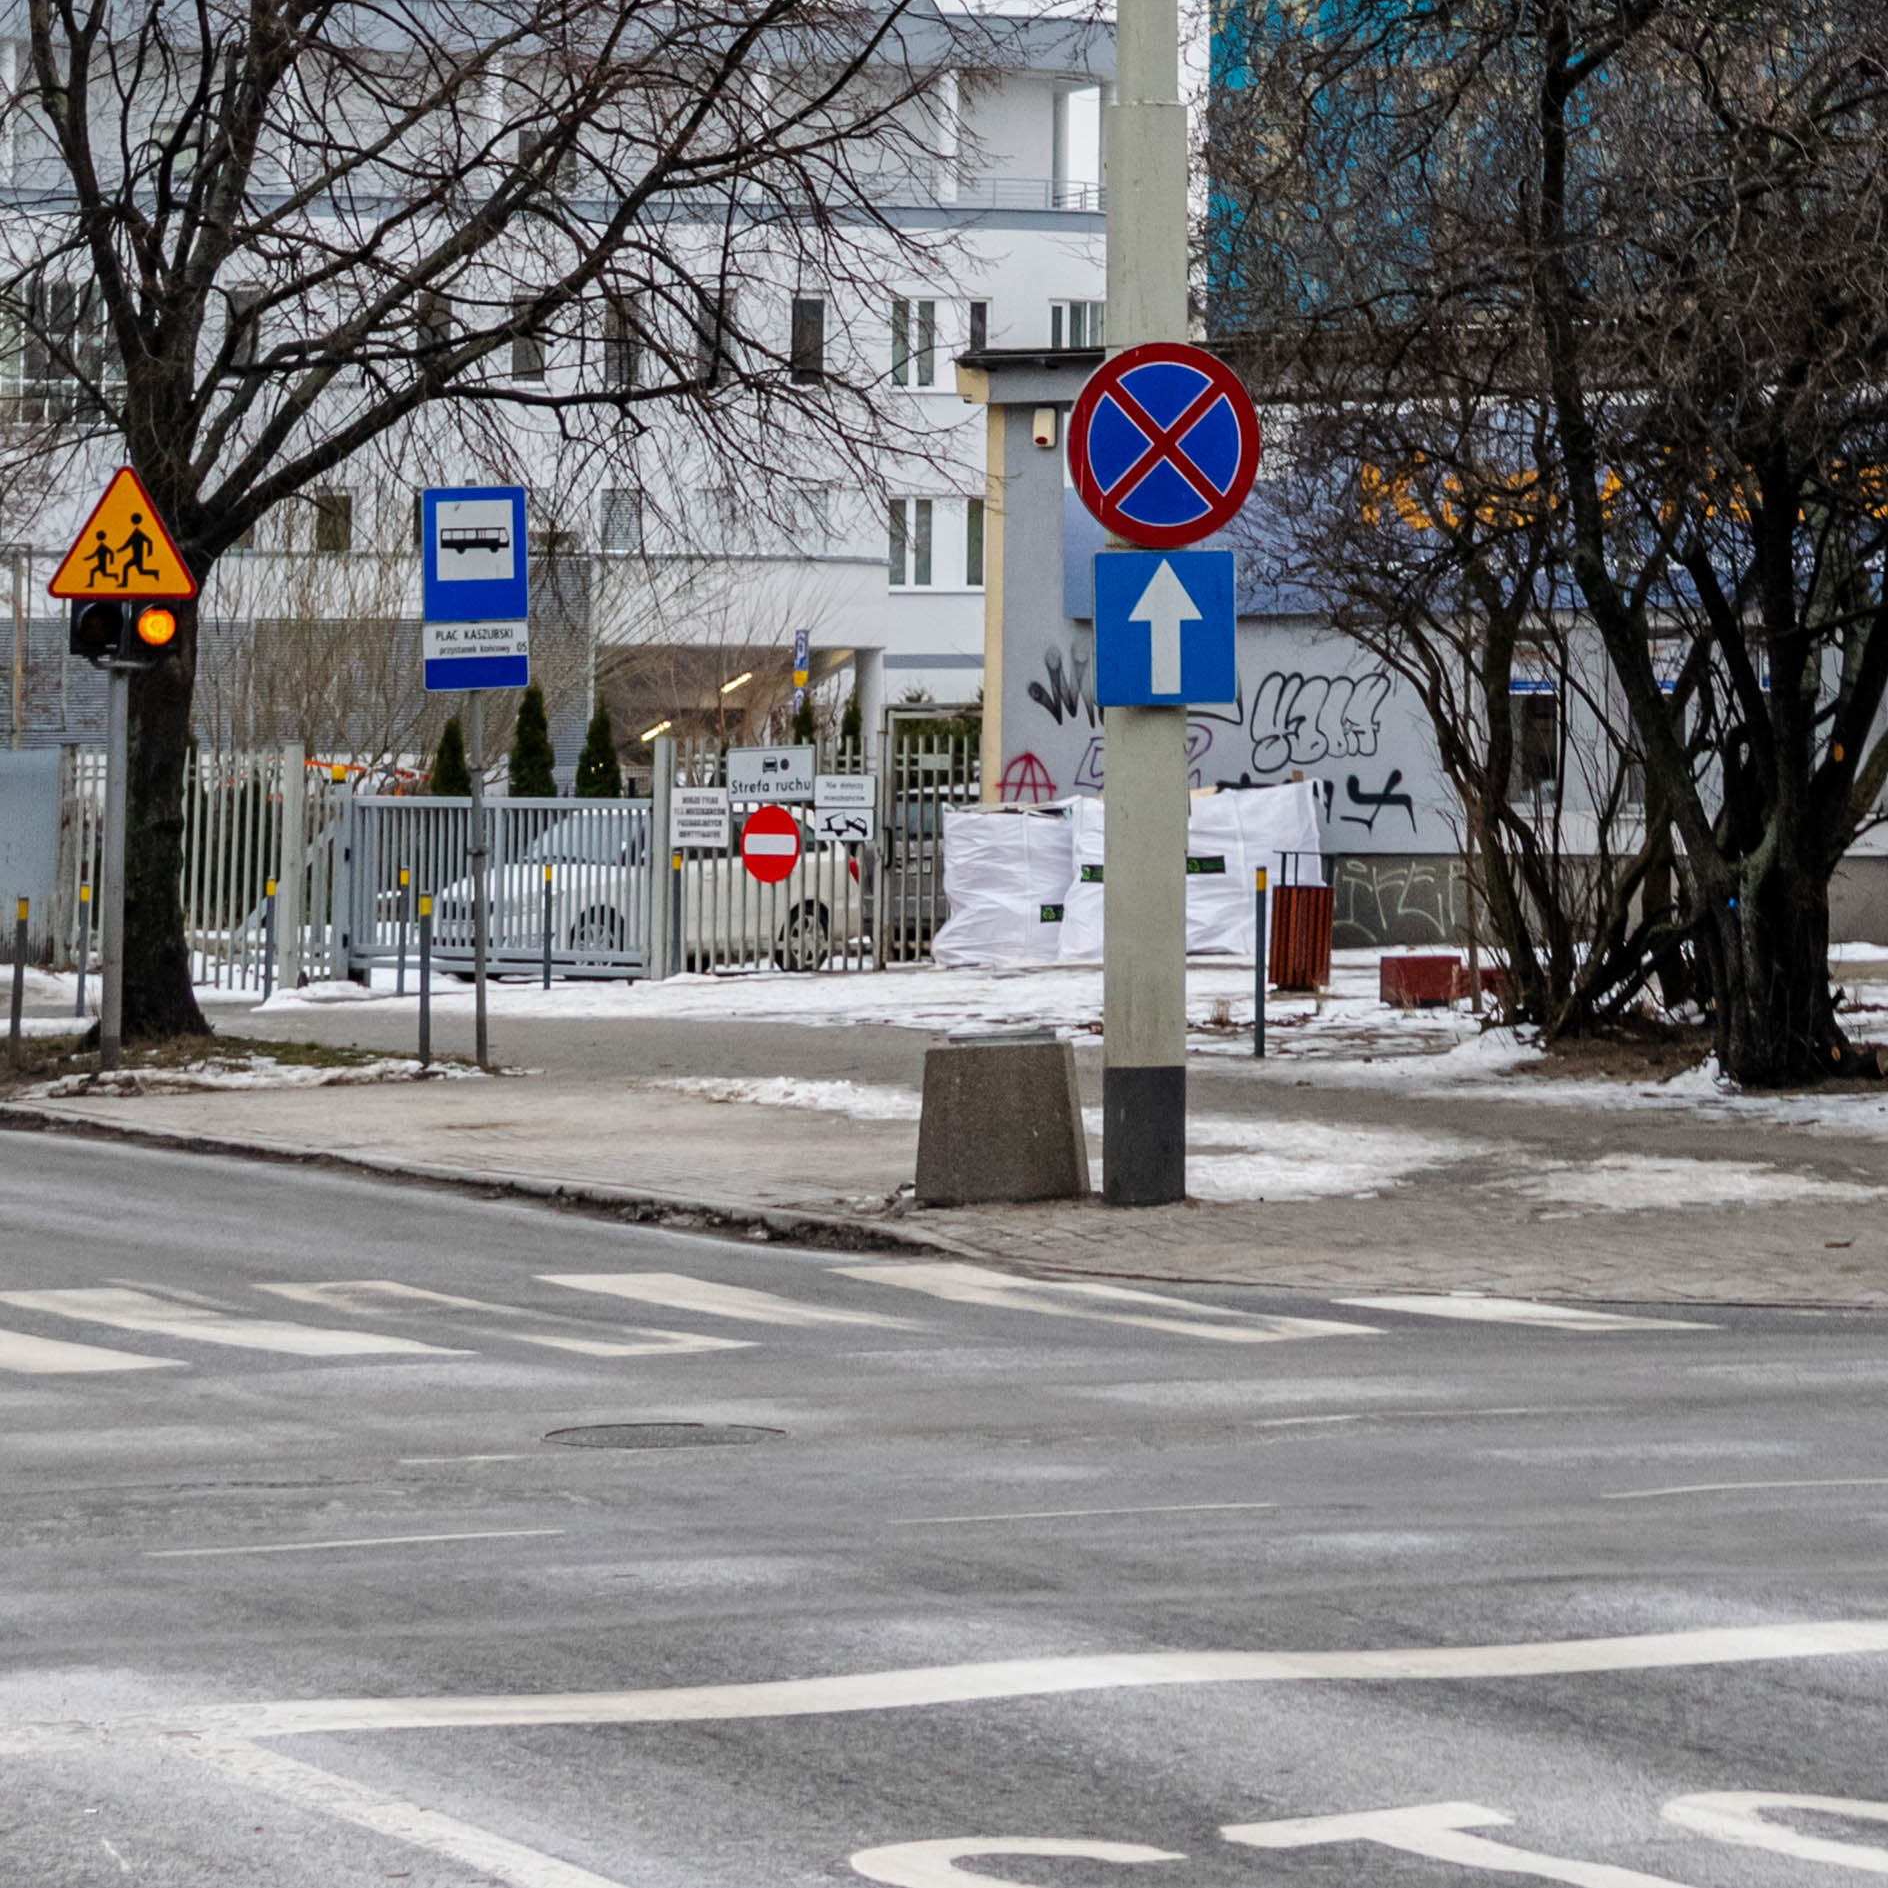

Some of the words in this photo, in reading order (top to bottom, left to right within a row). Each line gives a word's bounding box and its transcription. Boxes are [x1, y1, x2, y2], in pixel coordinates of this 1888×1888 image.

[435, 629, 458, 641] PLAC
[464, 628, 513, 640] KASZUBSKI
[516, 641, 528, 652] 05
[731, 778, 770, 795] Strefa
[775, 776, 812, 792] ruchu
